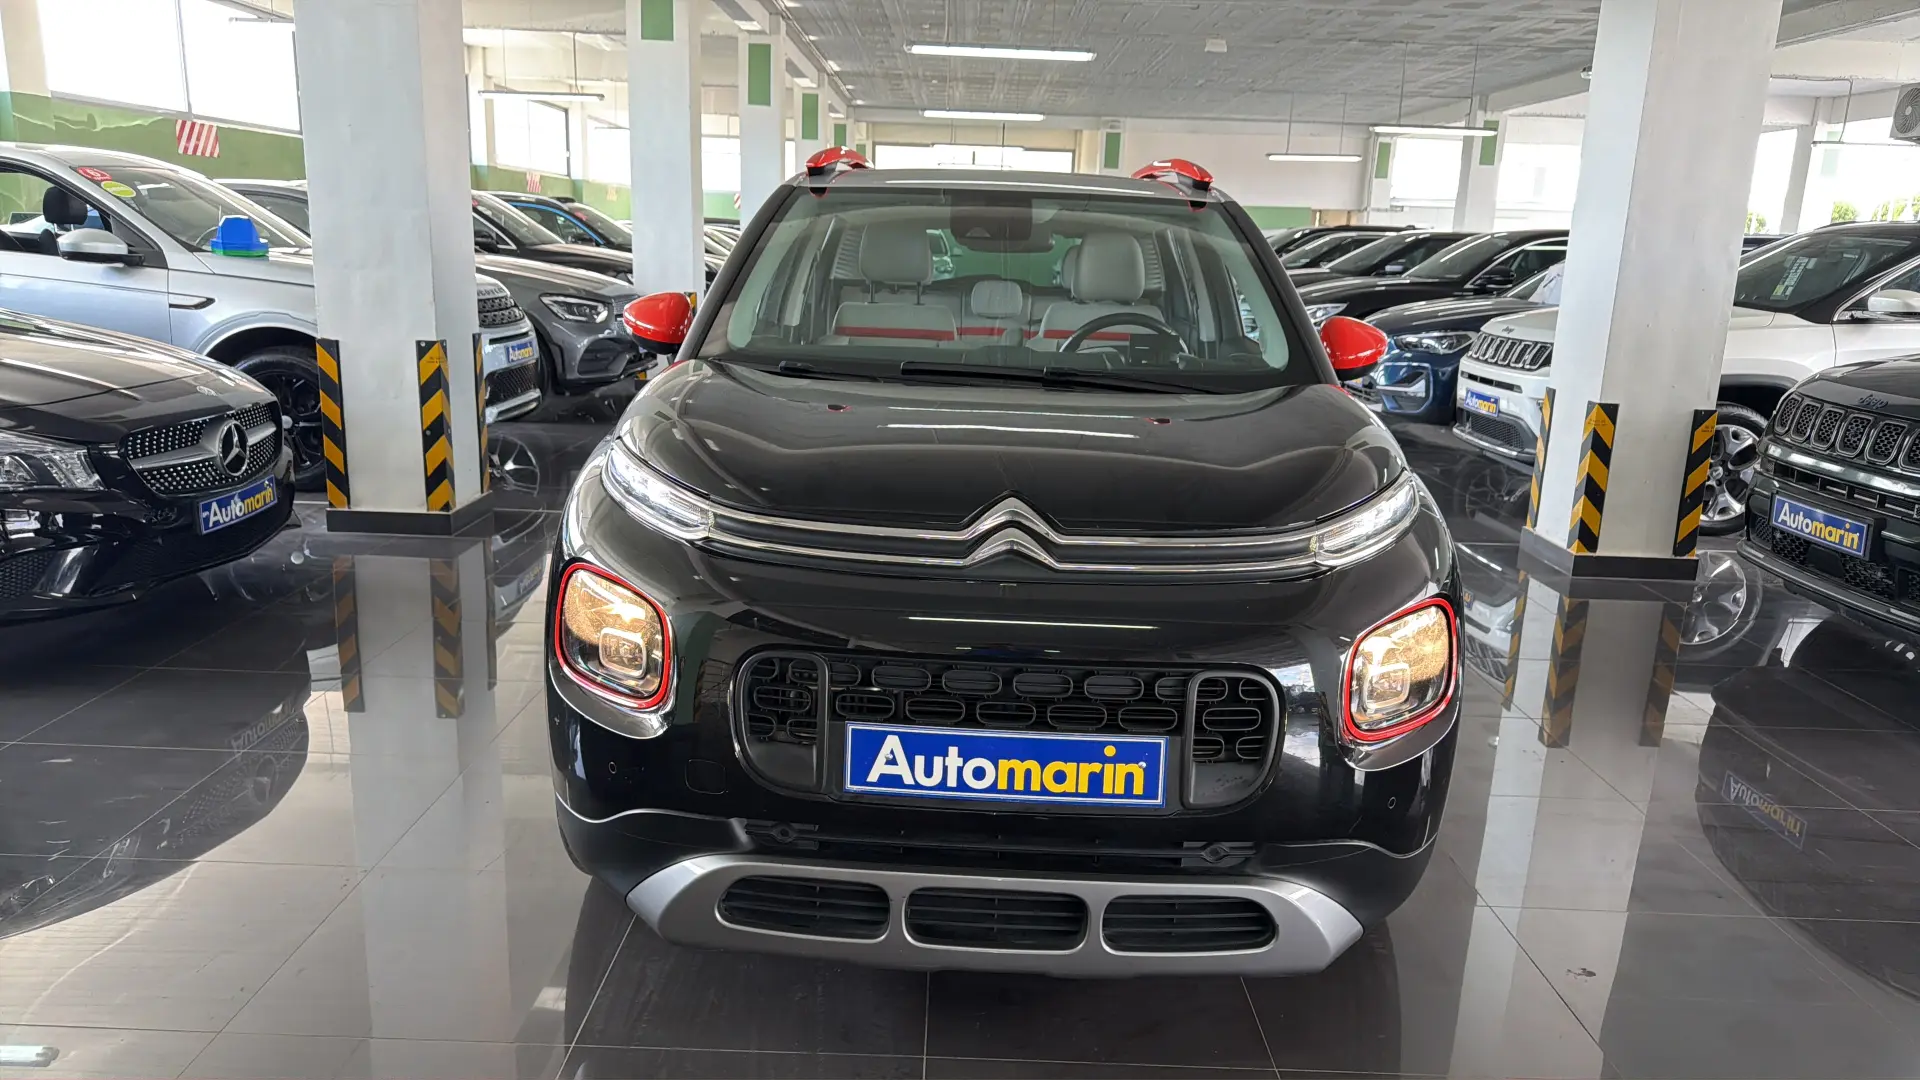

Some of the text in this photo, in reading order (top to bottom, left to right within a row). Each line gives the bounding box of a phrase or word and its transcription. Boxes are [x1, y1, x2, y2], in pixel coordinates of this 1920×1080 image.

[1466, 391, 1497, 413] Automarin
[209, 482, 273, 527] Automarin
[1778, 503, 1859, 549] Automarin
[866, 735, 1144, 795] Automarin
